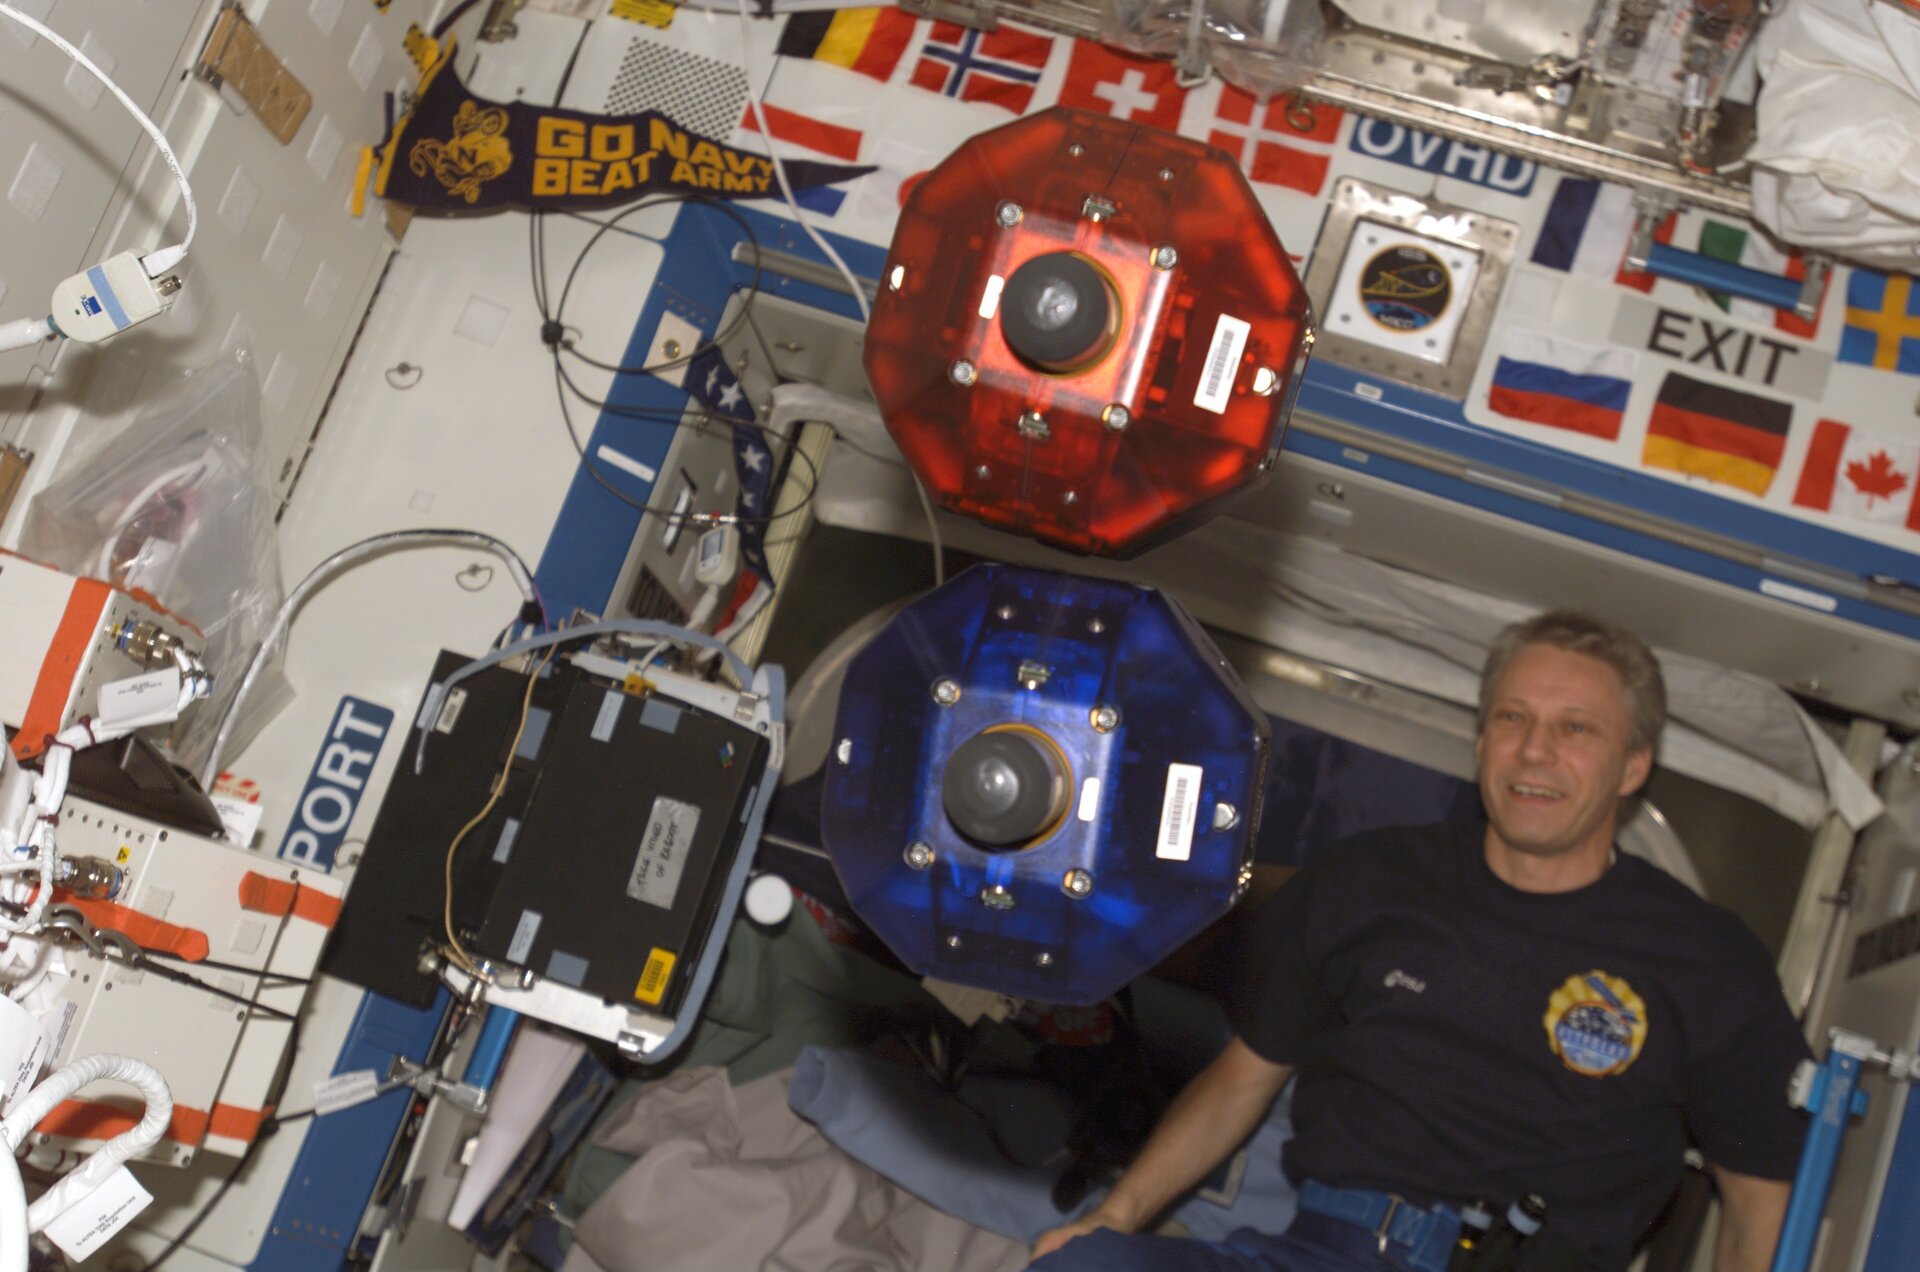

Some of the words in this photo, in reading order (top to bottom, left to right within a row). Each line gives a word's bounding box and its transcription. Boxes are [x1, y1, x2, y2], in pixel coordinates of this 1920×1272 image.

[455, 147, 478, 165] N
[531, 150, 659, 196] BEAT
[670, 162, 774, 192] ARMY
[536, 116, 634, 161] GO
[649, 118, 774, 177] NAVY
[1357, 115, 1537, 192] OVHD
[1647, 307, 1798, 385] EXIT
[282, 701, 385, 873] PORT
